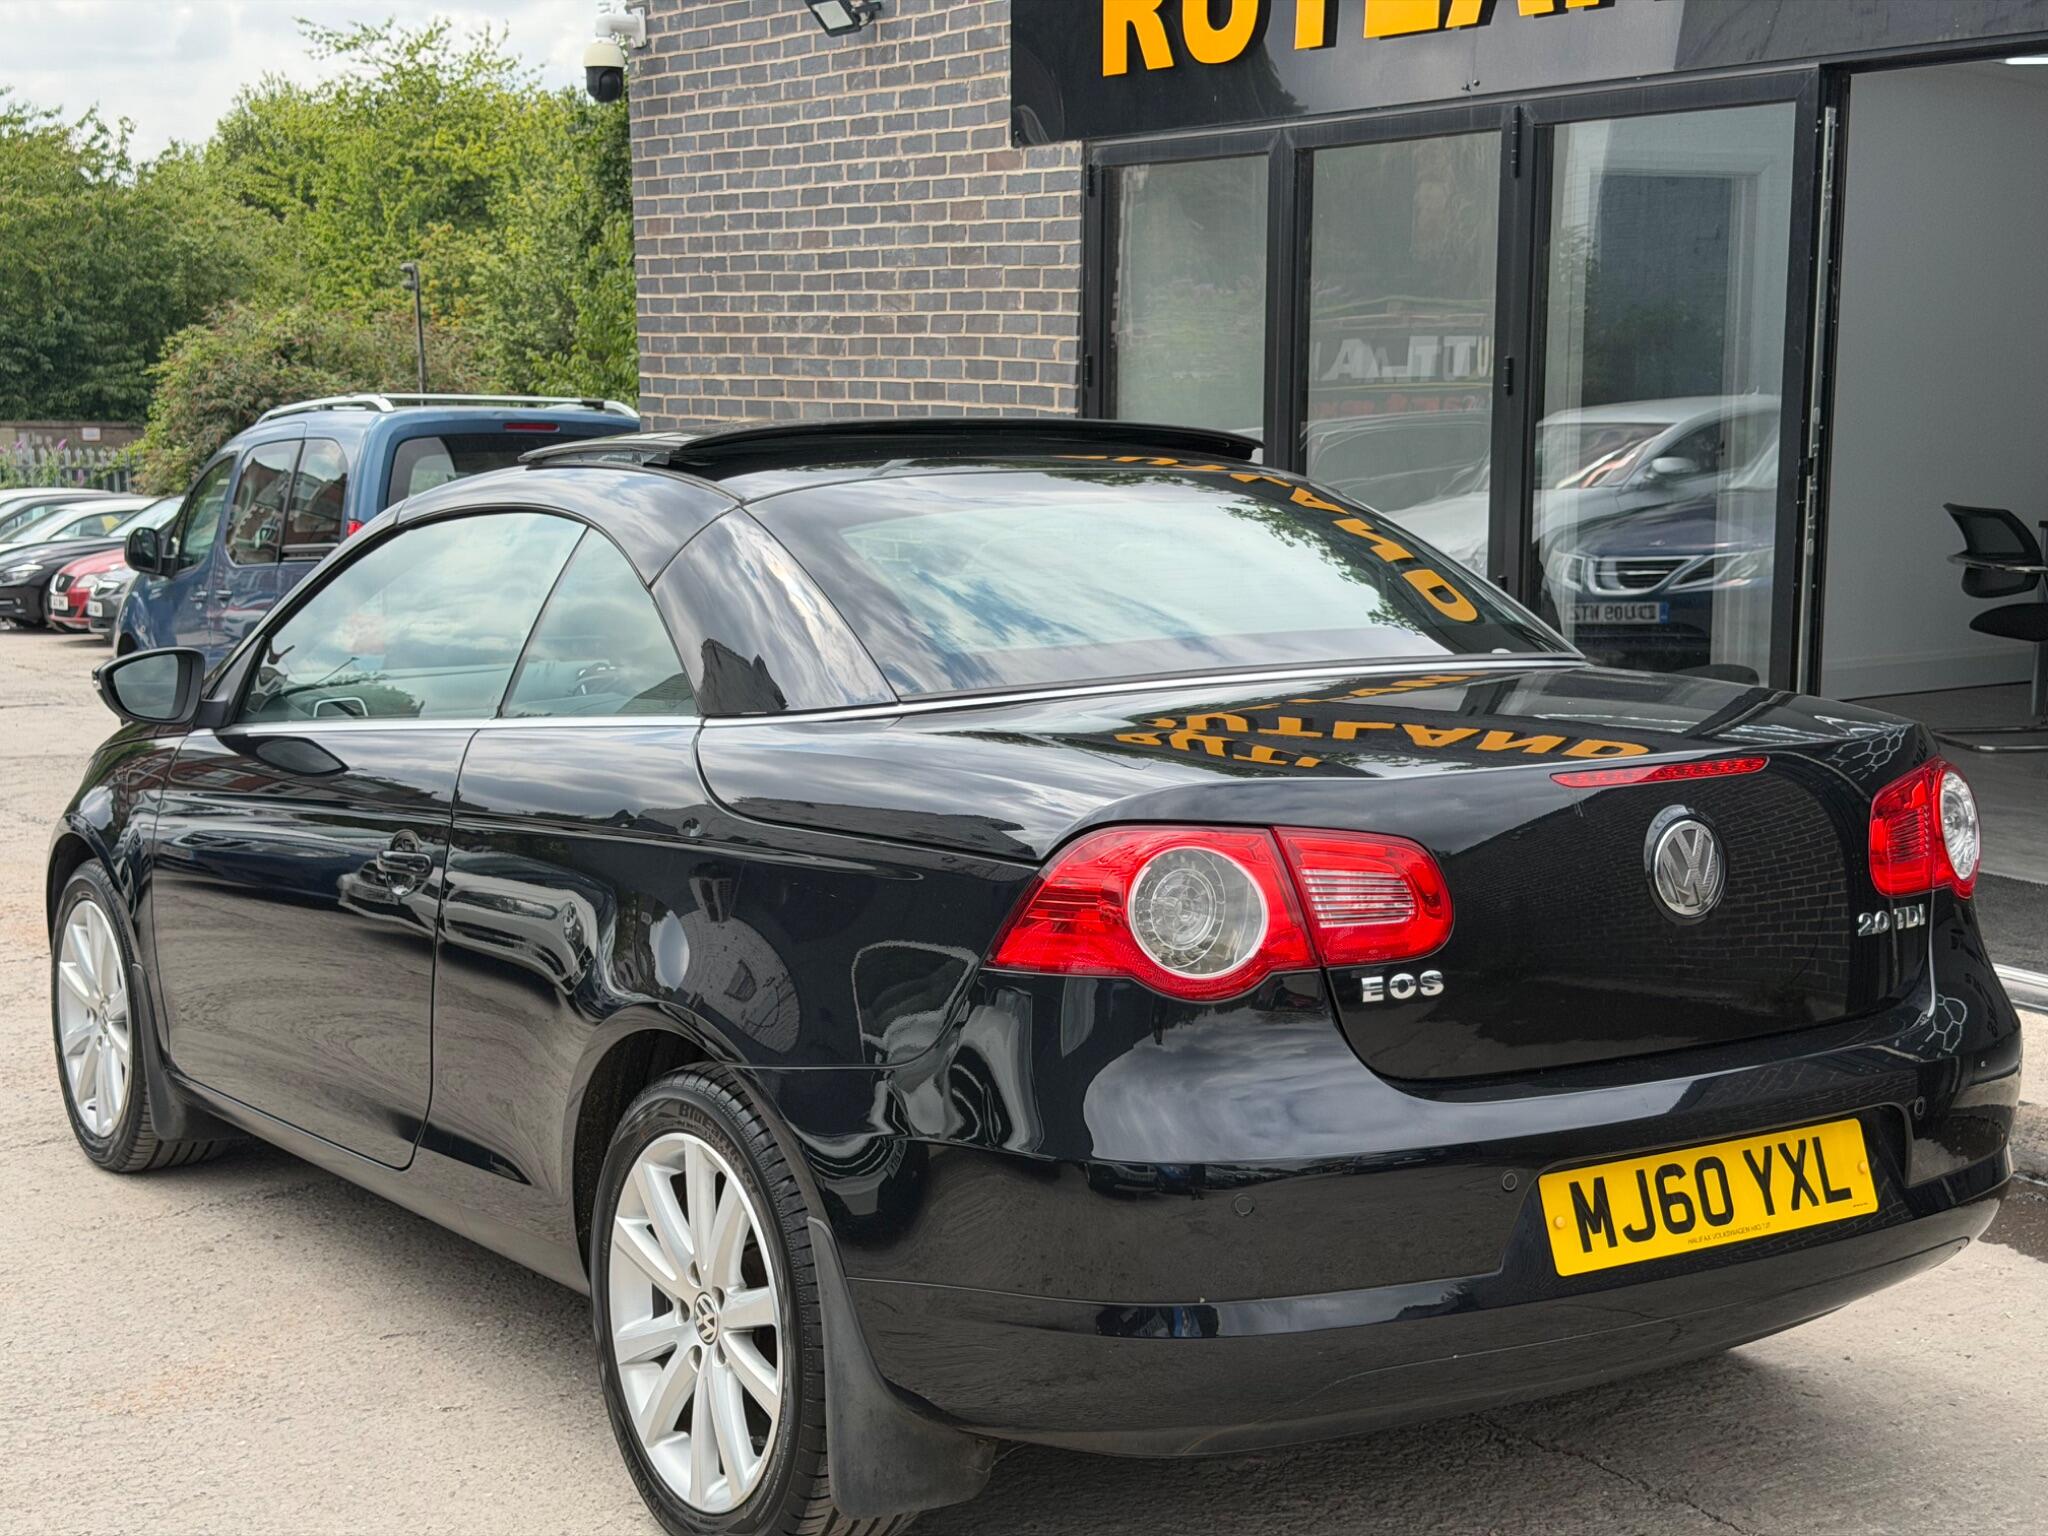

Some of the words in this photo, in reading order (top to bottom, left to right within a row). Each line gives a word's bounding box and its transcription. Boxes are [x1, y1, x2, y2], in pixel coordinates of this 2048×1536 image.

[1857, 910, 1891, 937] 2.0
[1893, 903, 1926, 930] TDI
[1361, 969, 1445, 1003] EOS
[1568, 1155, 1735, 1254] MJ60
[1742, 1136, 1853, 1217] YXL
